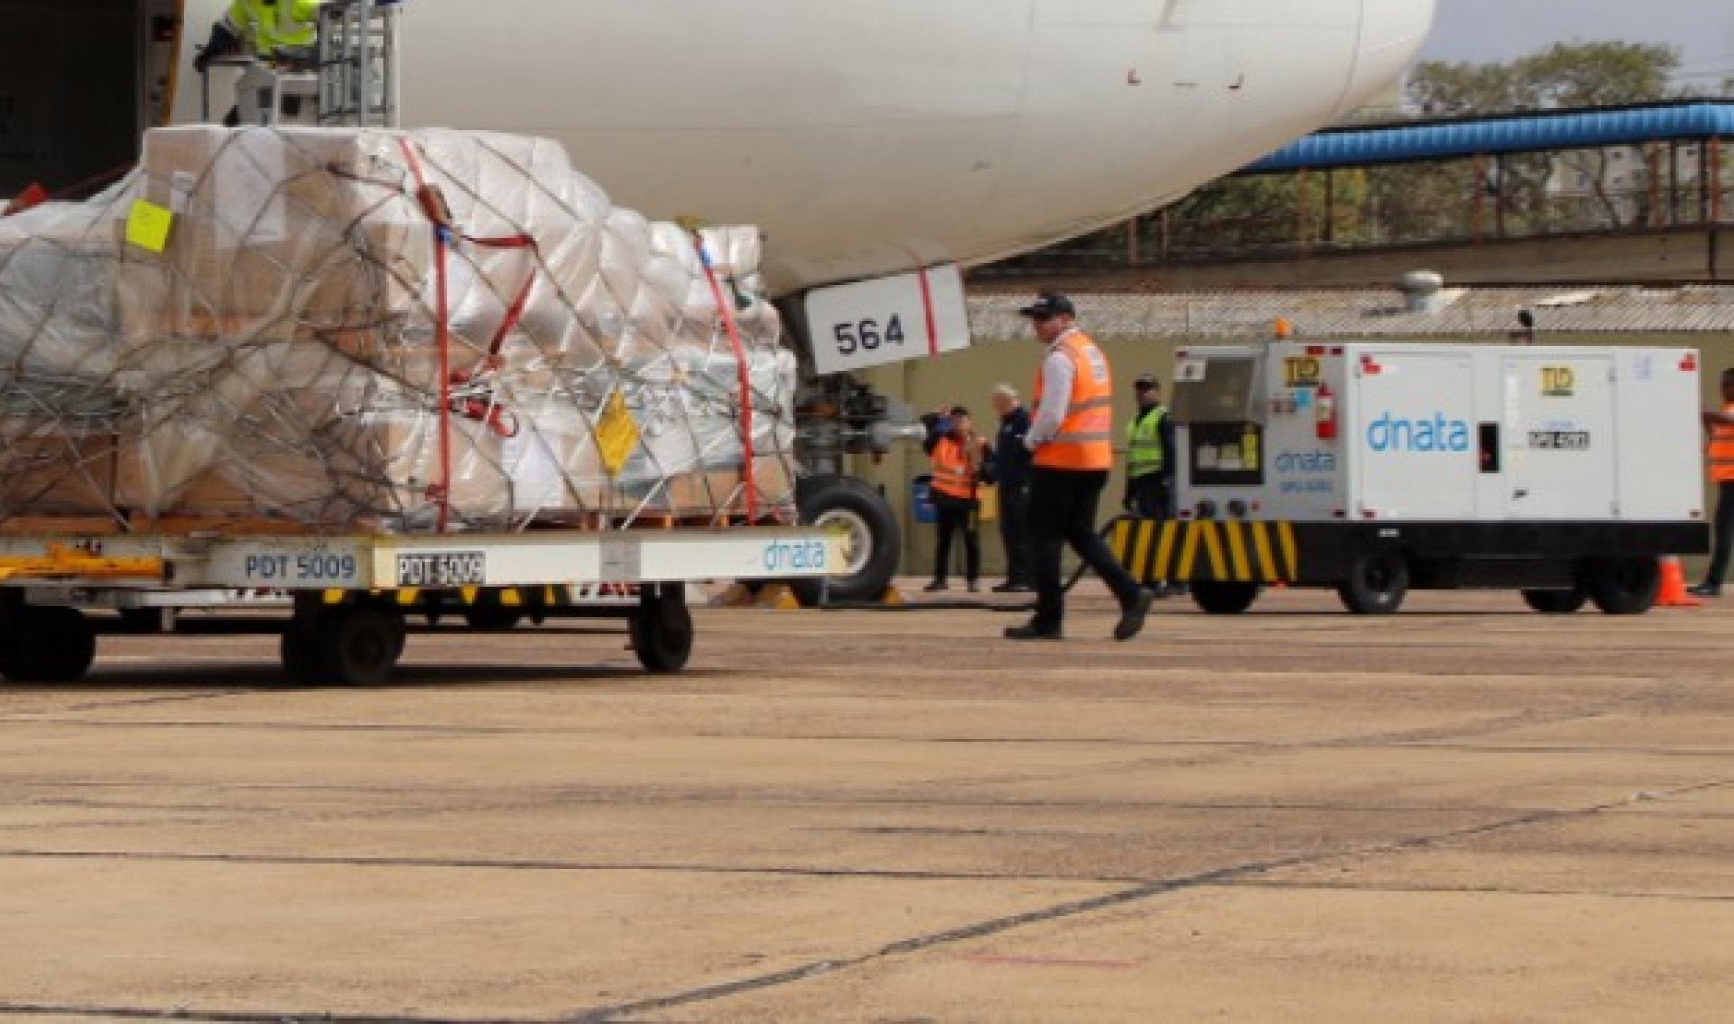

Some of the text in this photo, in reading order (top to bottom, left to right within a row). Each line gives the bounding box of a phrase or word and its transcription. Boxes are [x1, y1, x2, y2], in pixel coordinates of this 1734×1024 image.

[833, 313, 904, 355] 564
[1367, 410, 1469, 451] dnata
[1275, 449, 1336, 473] dnata
[245, 555, 356, 579] PDT 5009
[765, 536, 826, 571] dnata
[399, 556, 432, 584] PDT
